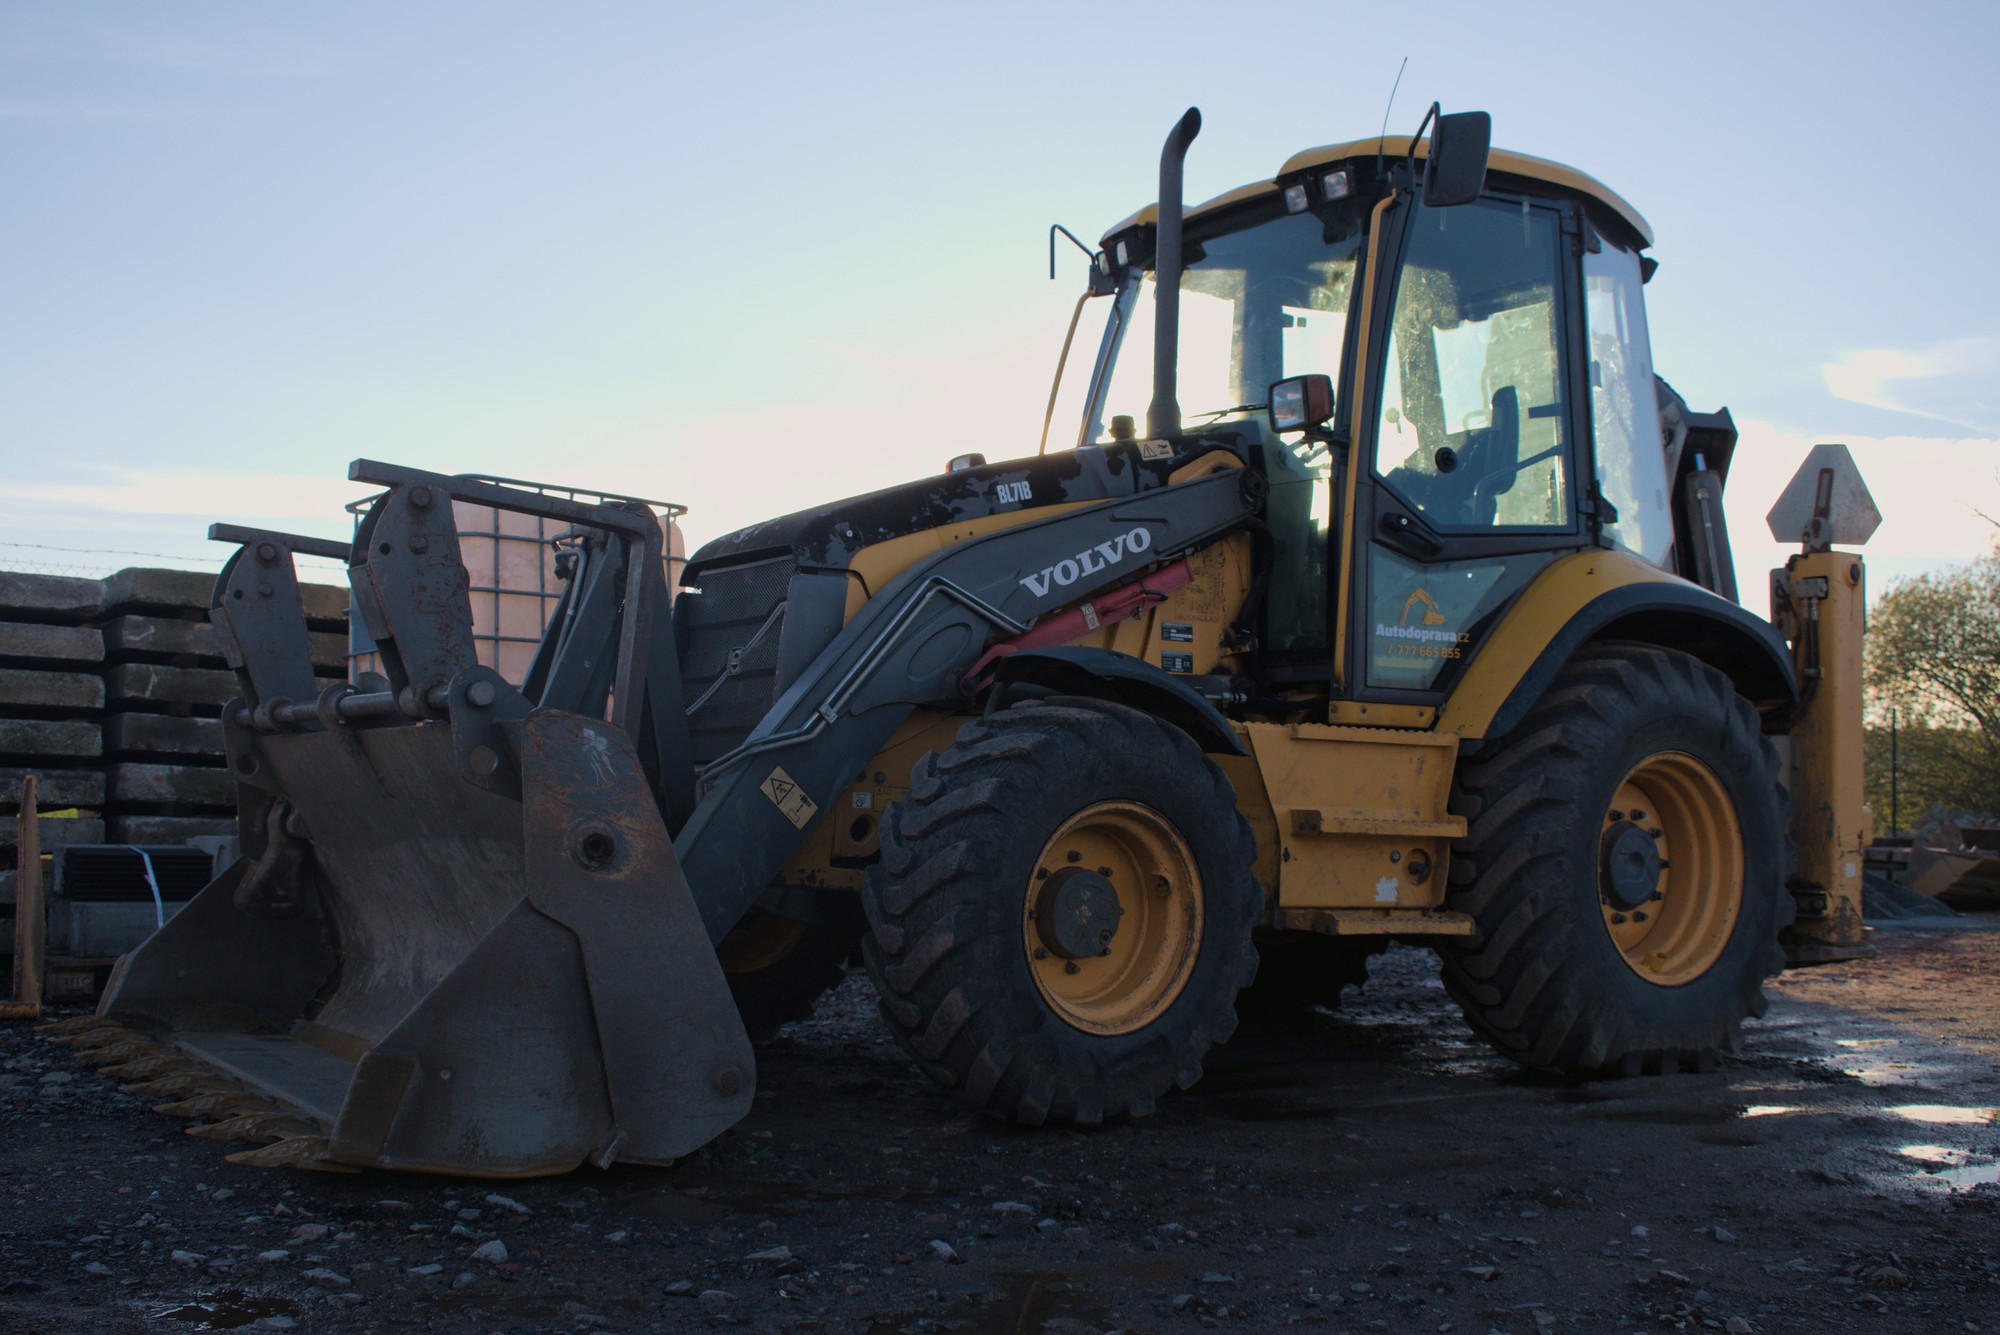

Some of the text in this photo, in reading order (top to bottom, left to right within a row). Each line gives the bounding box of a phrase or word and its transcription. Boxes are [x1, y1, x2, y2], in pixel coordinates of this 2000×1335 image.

[997, 481, 1032, 504] BL71B
[1019, 527, 1151, 598] VOLVO
[1397, 645, 1416, 656] 777
[1441, 648, 1461, 659] 855
